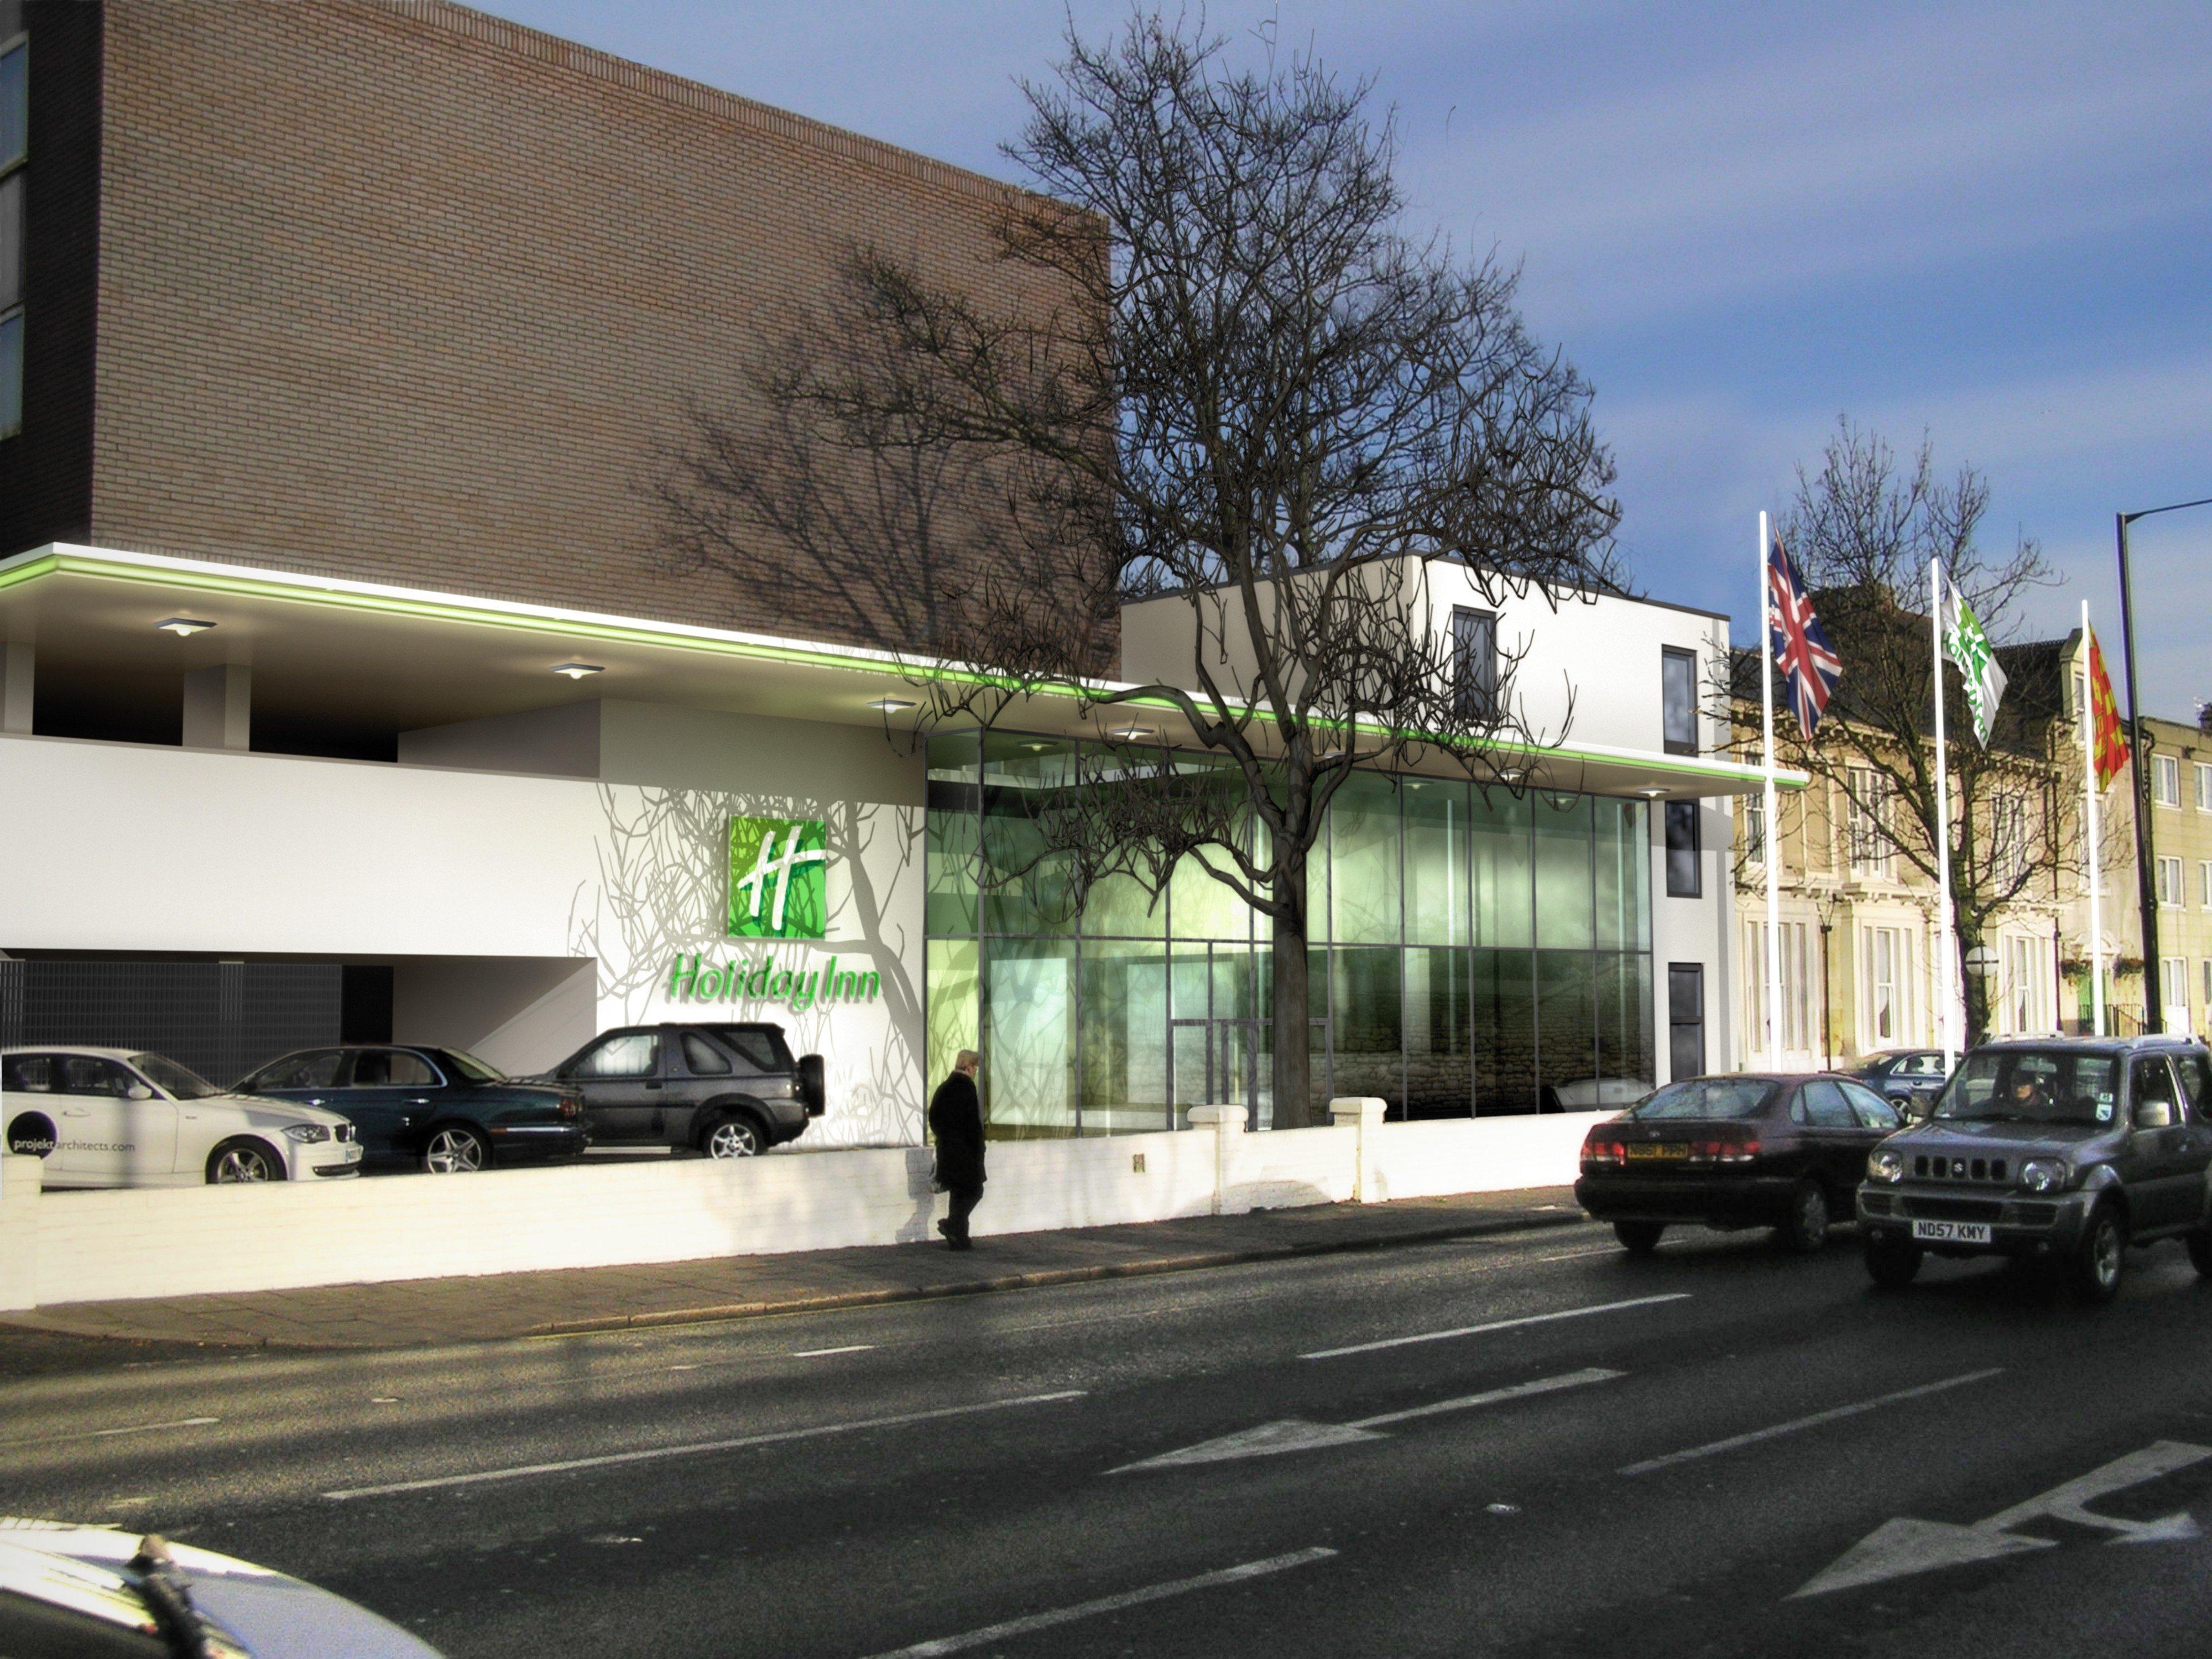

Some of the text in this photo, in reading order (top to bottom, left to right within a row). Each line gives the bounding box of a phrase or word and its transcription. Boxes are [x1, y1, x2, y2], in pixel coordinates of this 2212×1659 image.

[667, 952, 881, 1011] Holiday Inn
[1918, 1222, 1985, 1240] ND57 KMY
